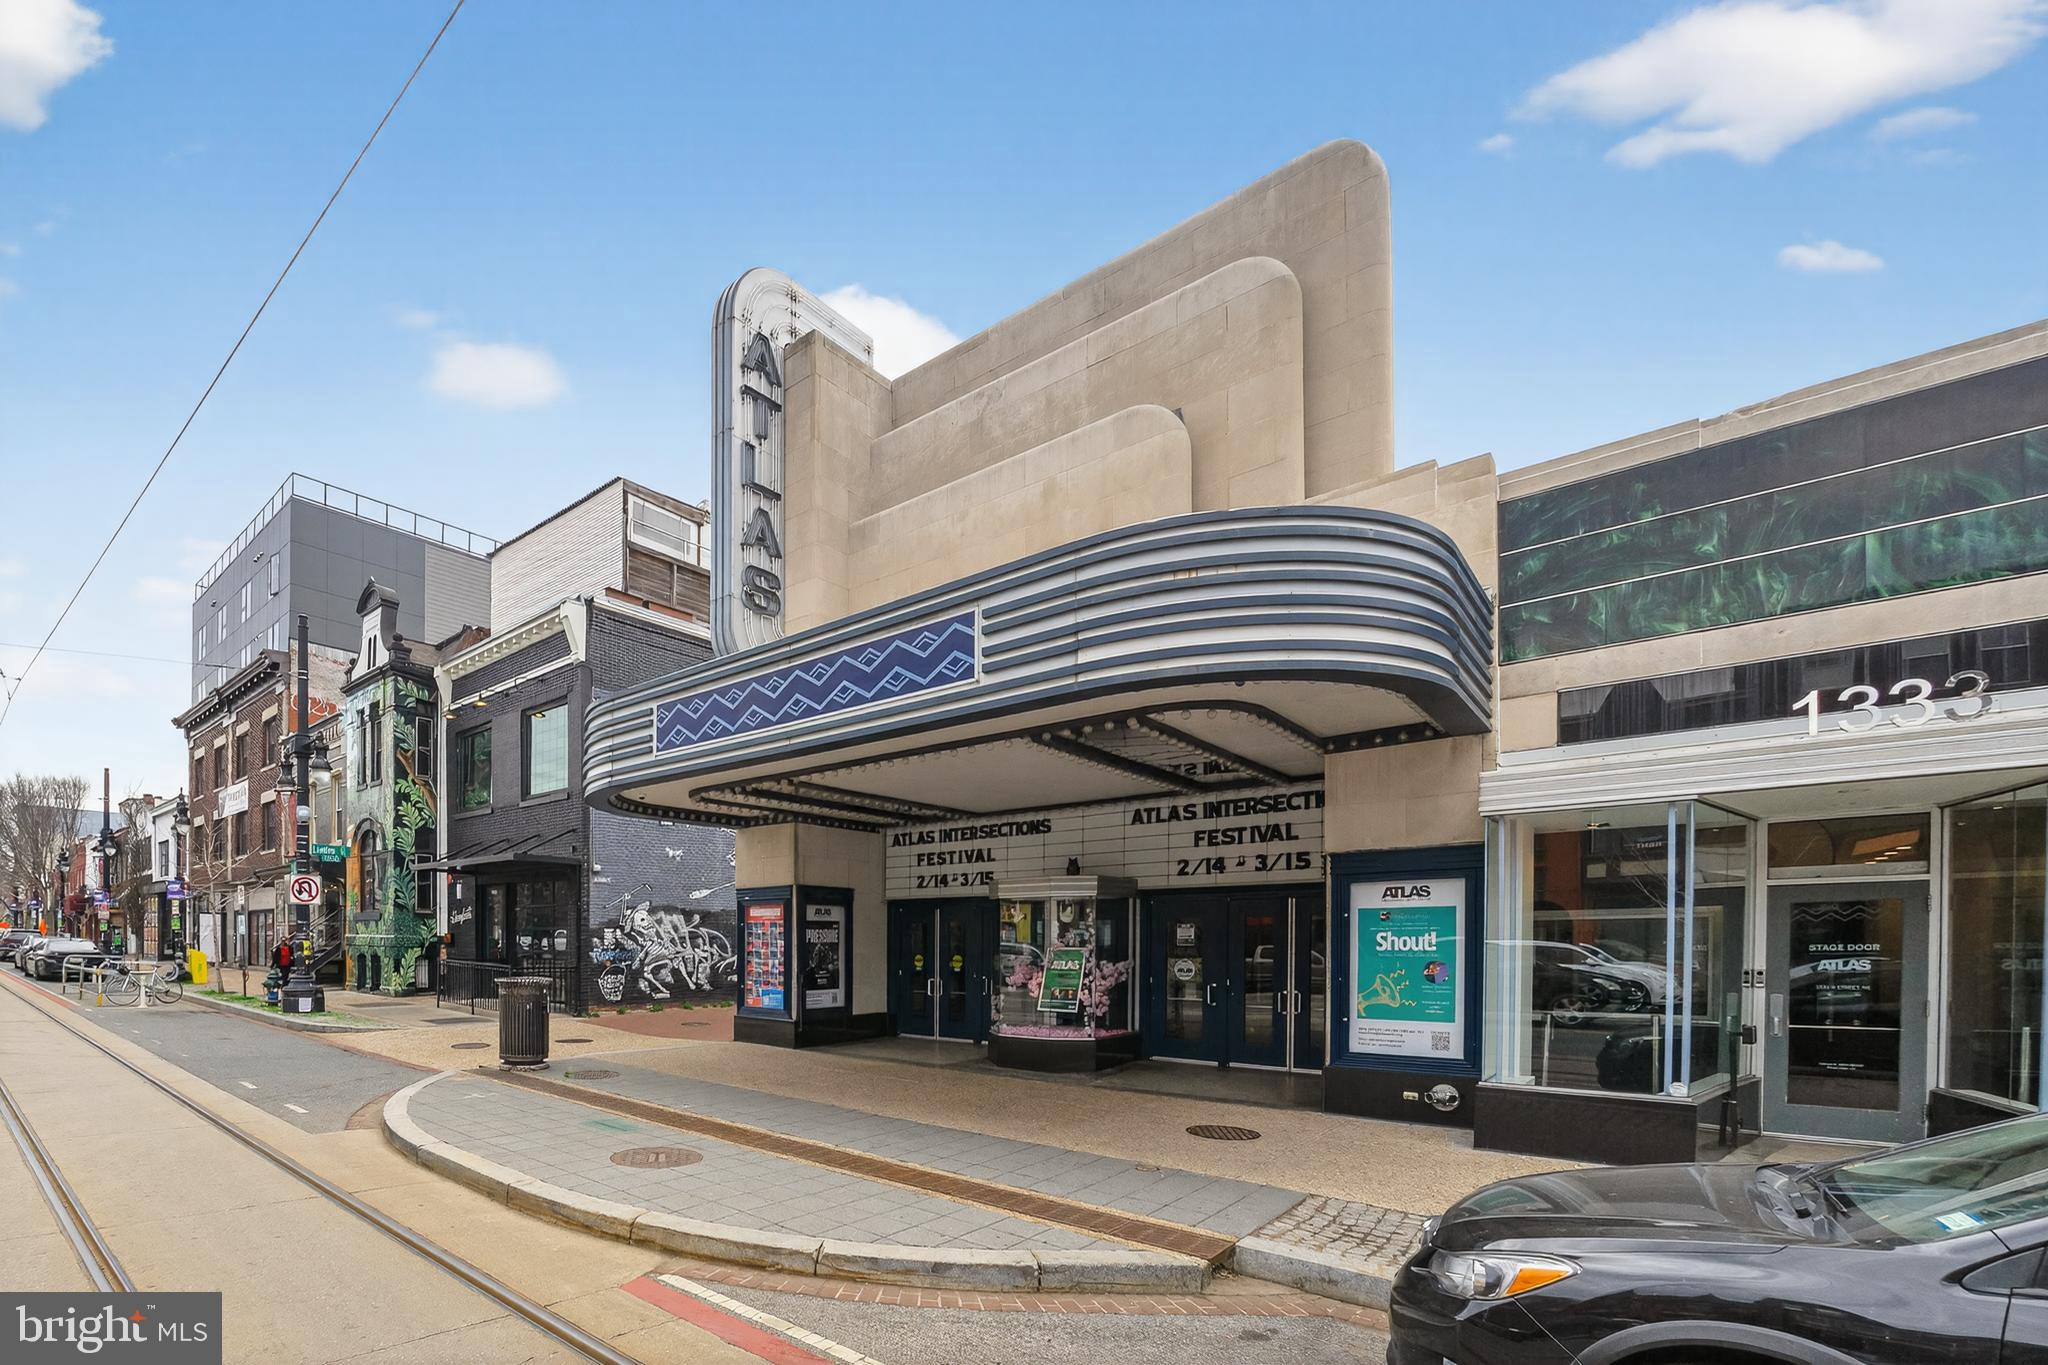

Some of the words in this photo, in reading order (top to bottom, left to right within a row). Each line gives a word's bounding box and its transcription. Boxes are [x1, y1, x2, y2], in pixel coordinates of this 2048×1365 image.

[741, 331, 782, 617] ATLAS
[1792, 669, 1993, 737] 1333
[1131, 803, 1197, 825] ATLAS
[1203, 790, 1326, 819] INTERSECTI
[892, 831, 935, 847] ATLAS
[939, 818, 1051, 843] INTERSECTIONS
[1194, 822, 1299, 847] FESTIVAL
[917, 848, 996, 866] FESTIVAL
[1177, 856, 1226, 876] 2/14
[1255, 851, 1311, 872] 3/15
[917, 873, 948, 888] 2/14
[960, 871, 994, 887] 3/15
[1382, 885, 1431, 899] ATLAS
[1376, 931, 1437, 951] Shout!
[1808, 943, 1844, 951] STAGE
[1847, 943, 1880, 951] DOOR
[1817, 959, 1872, 971] ATLAS
